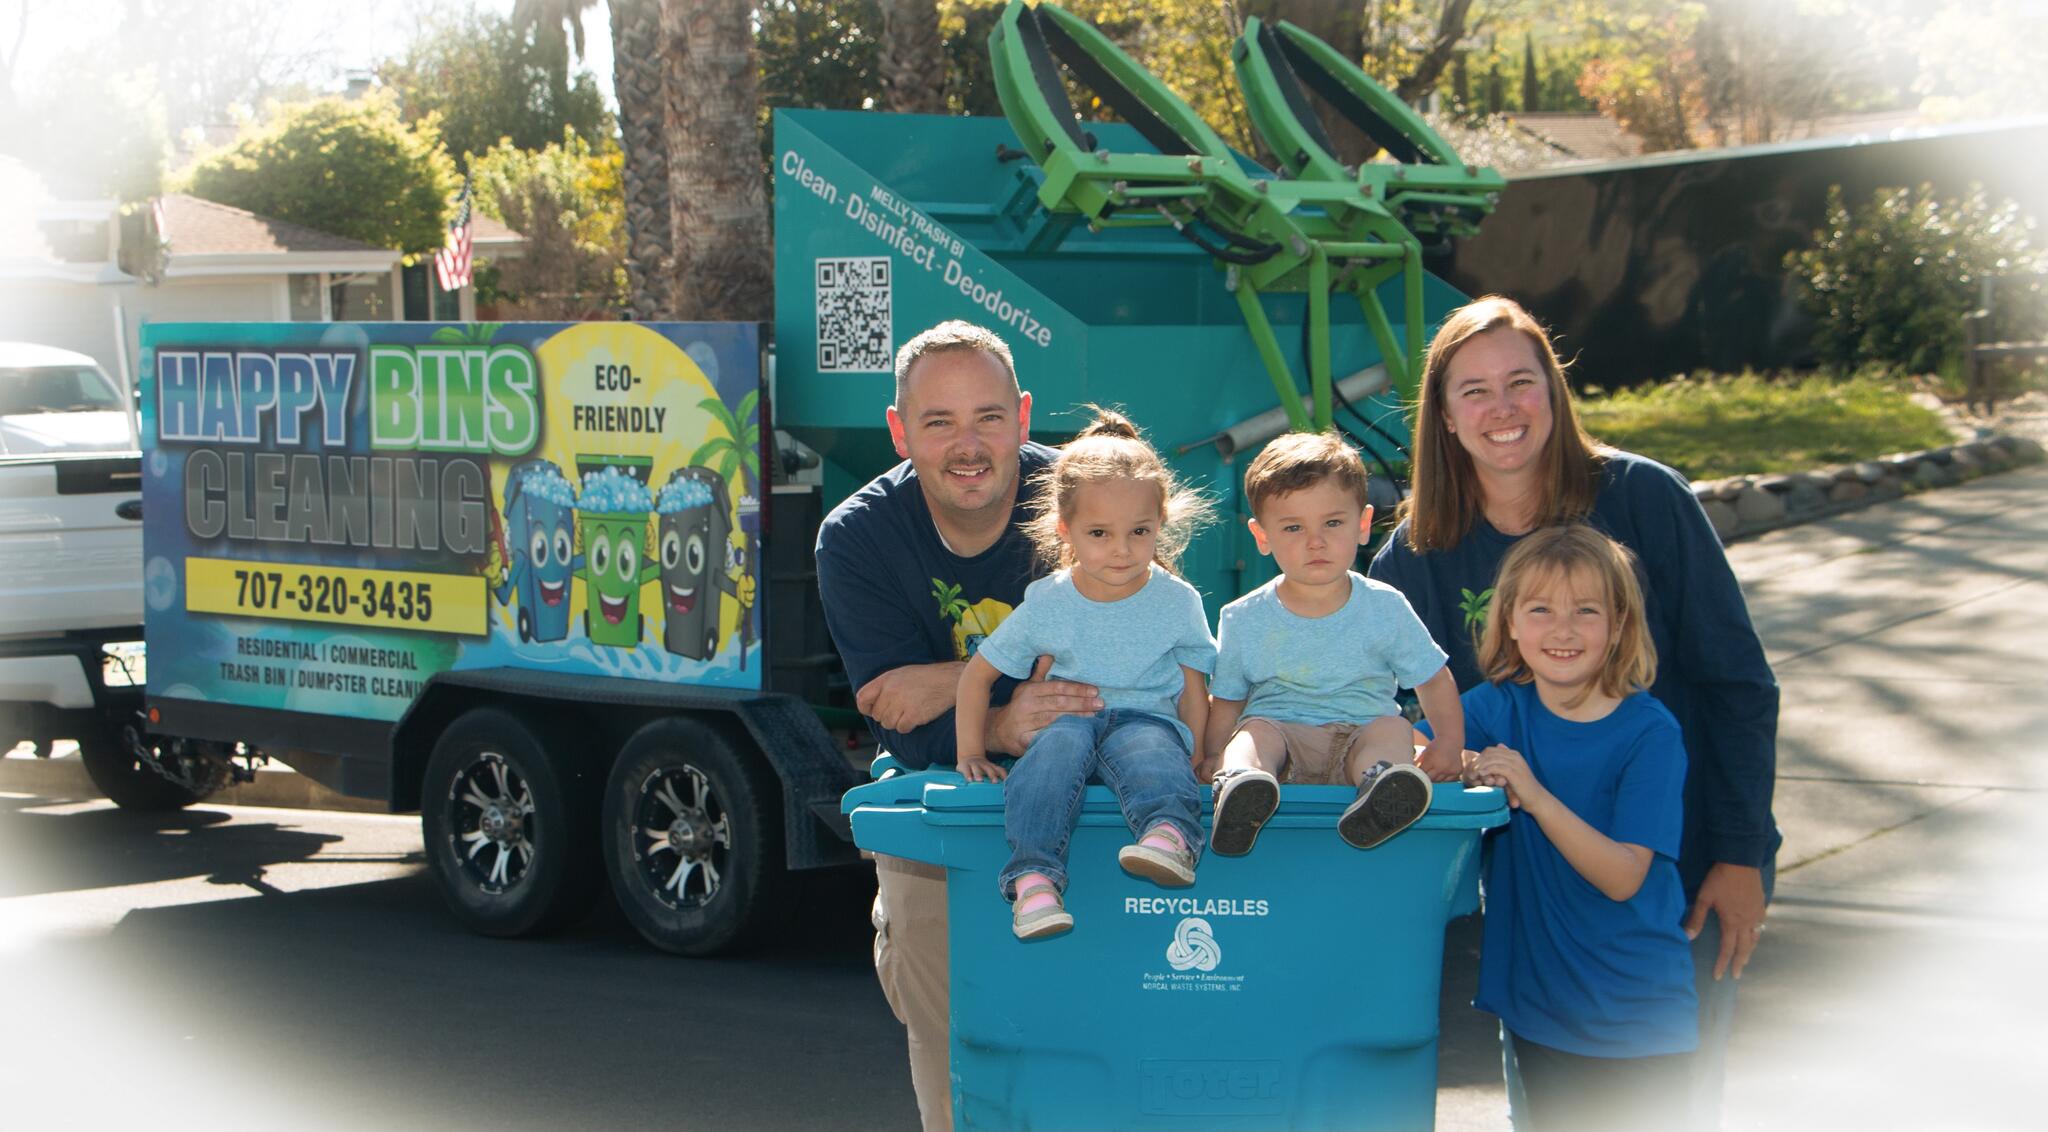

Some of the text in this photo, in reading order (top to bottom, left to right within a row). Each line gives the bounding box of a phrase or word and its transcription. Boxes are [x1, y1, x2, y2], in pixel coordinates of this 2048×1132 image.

[910, 210, 951, 249] TRASH
[782, 150, 837, 204] Clean
[845, 193, 936, 271] Disinfect
[943, 259, 1053, 348] Deodorize
[595, 364, 641, 391] ECO-
[158, 346, 539, 455] HAPPY BINS
[573, 405, 666, 433] FRIENDLY
[185, 449, 486, 554] CLEANING
[234, 570, 432, 622] 707-320-3435
[237, 636, 319, 662] RESIDENTIAL
[331, 644, 418, 670] COMMERCIAL
[220, 662, 260, 683] TRASH
[264, 667, 286, 686] BIN
[299, 670, 367, 694] DUMPSTER
[1124, 897, 1269, 916] RECYCLABLES
[1171, 983, 1193, 991] WASTE
